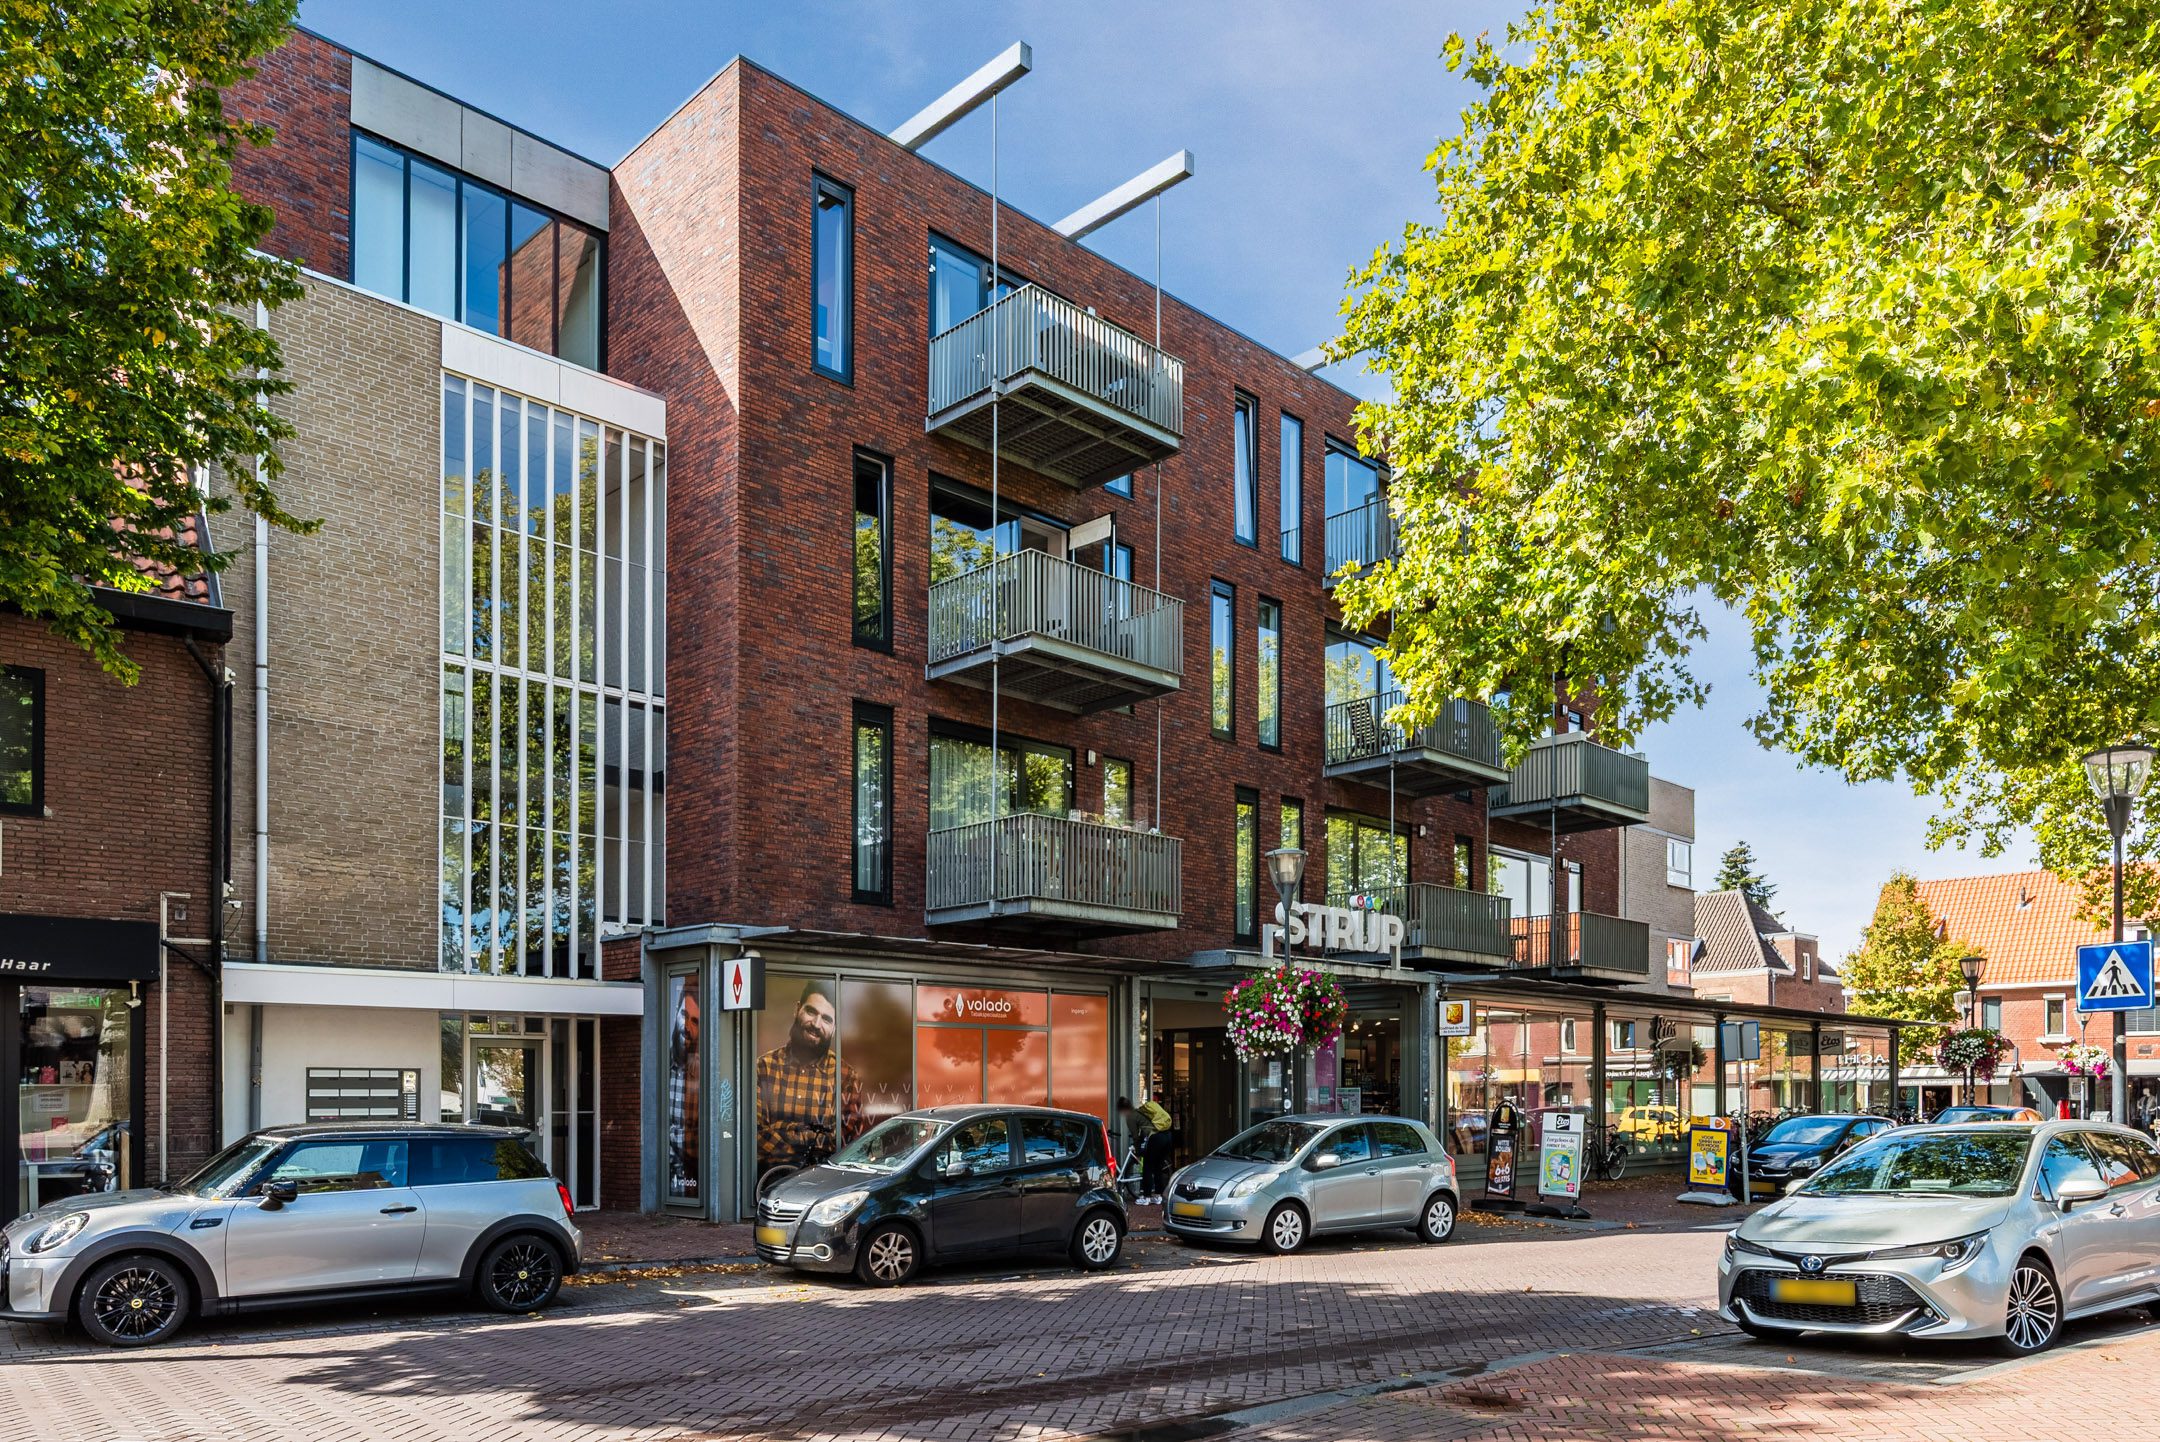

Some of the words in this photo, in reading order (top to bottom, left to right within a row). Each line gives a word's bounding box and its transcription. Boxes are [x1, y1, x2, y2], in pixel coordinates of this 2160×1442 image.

[1, 958, 51, 971] Haar
[966, 996, 1011, 1012] volado
[1821, 1035, 1840, 1050] Etos
[1494, 1162, 1510, 1176] 6+6
[678, 1177, 697, 1187] volado
[1494, 1175, 1511, 1184] GRATIS
